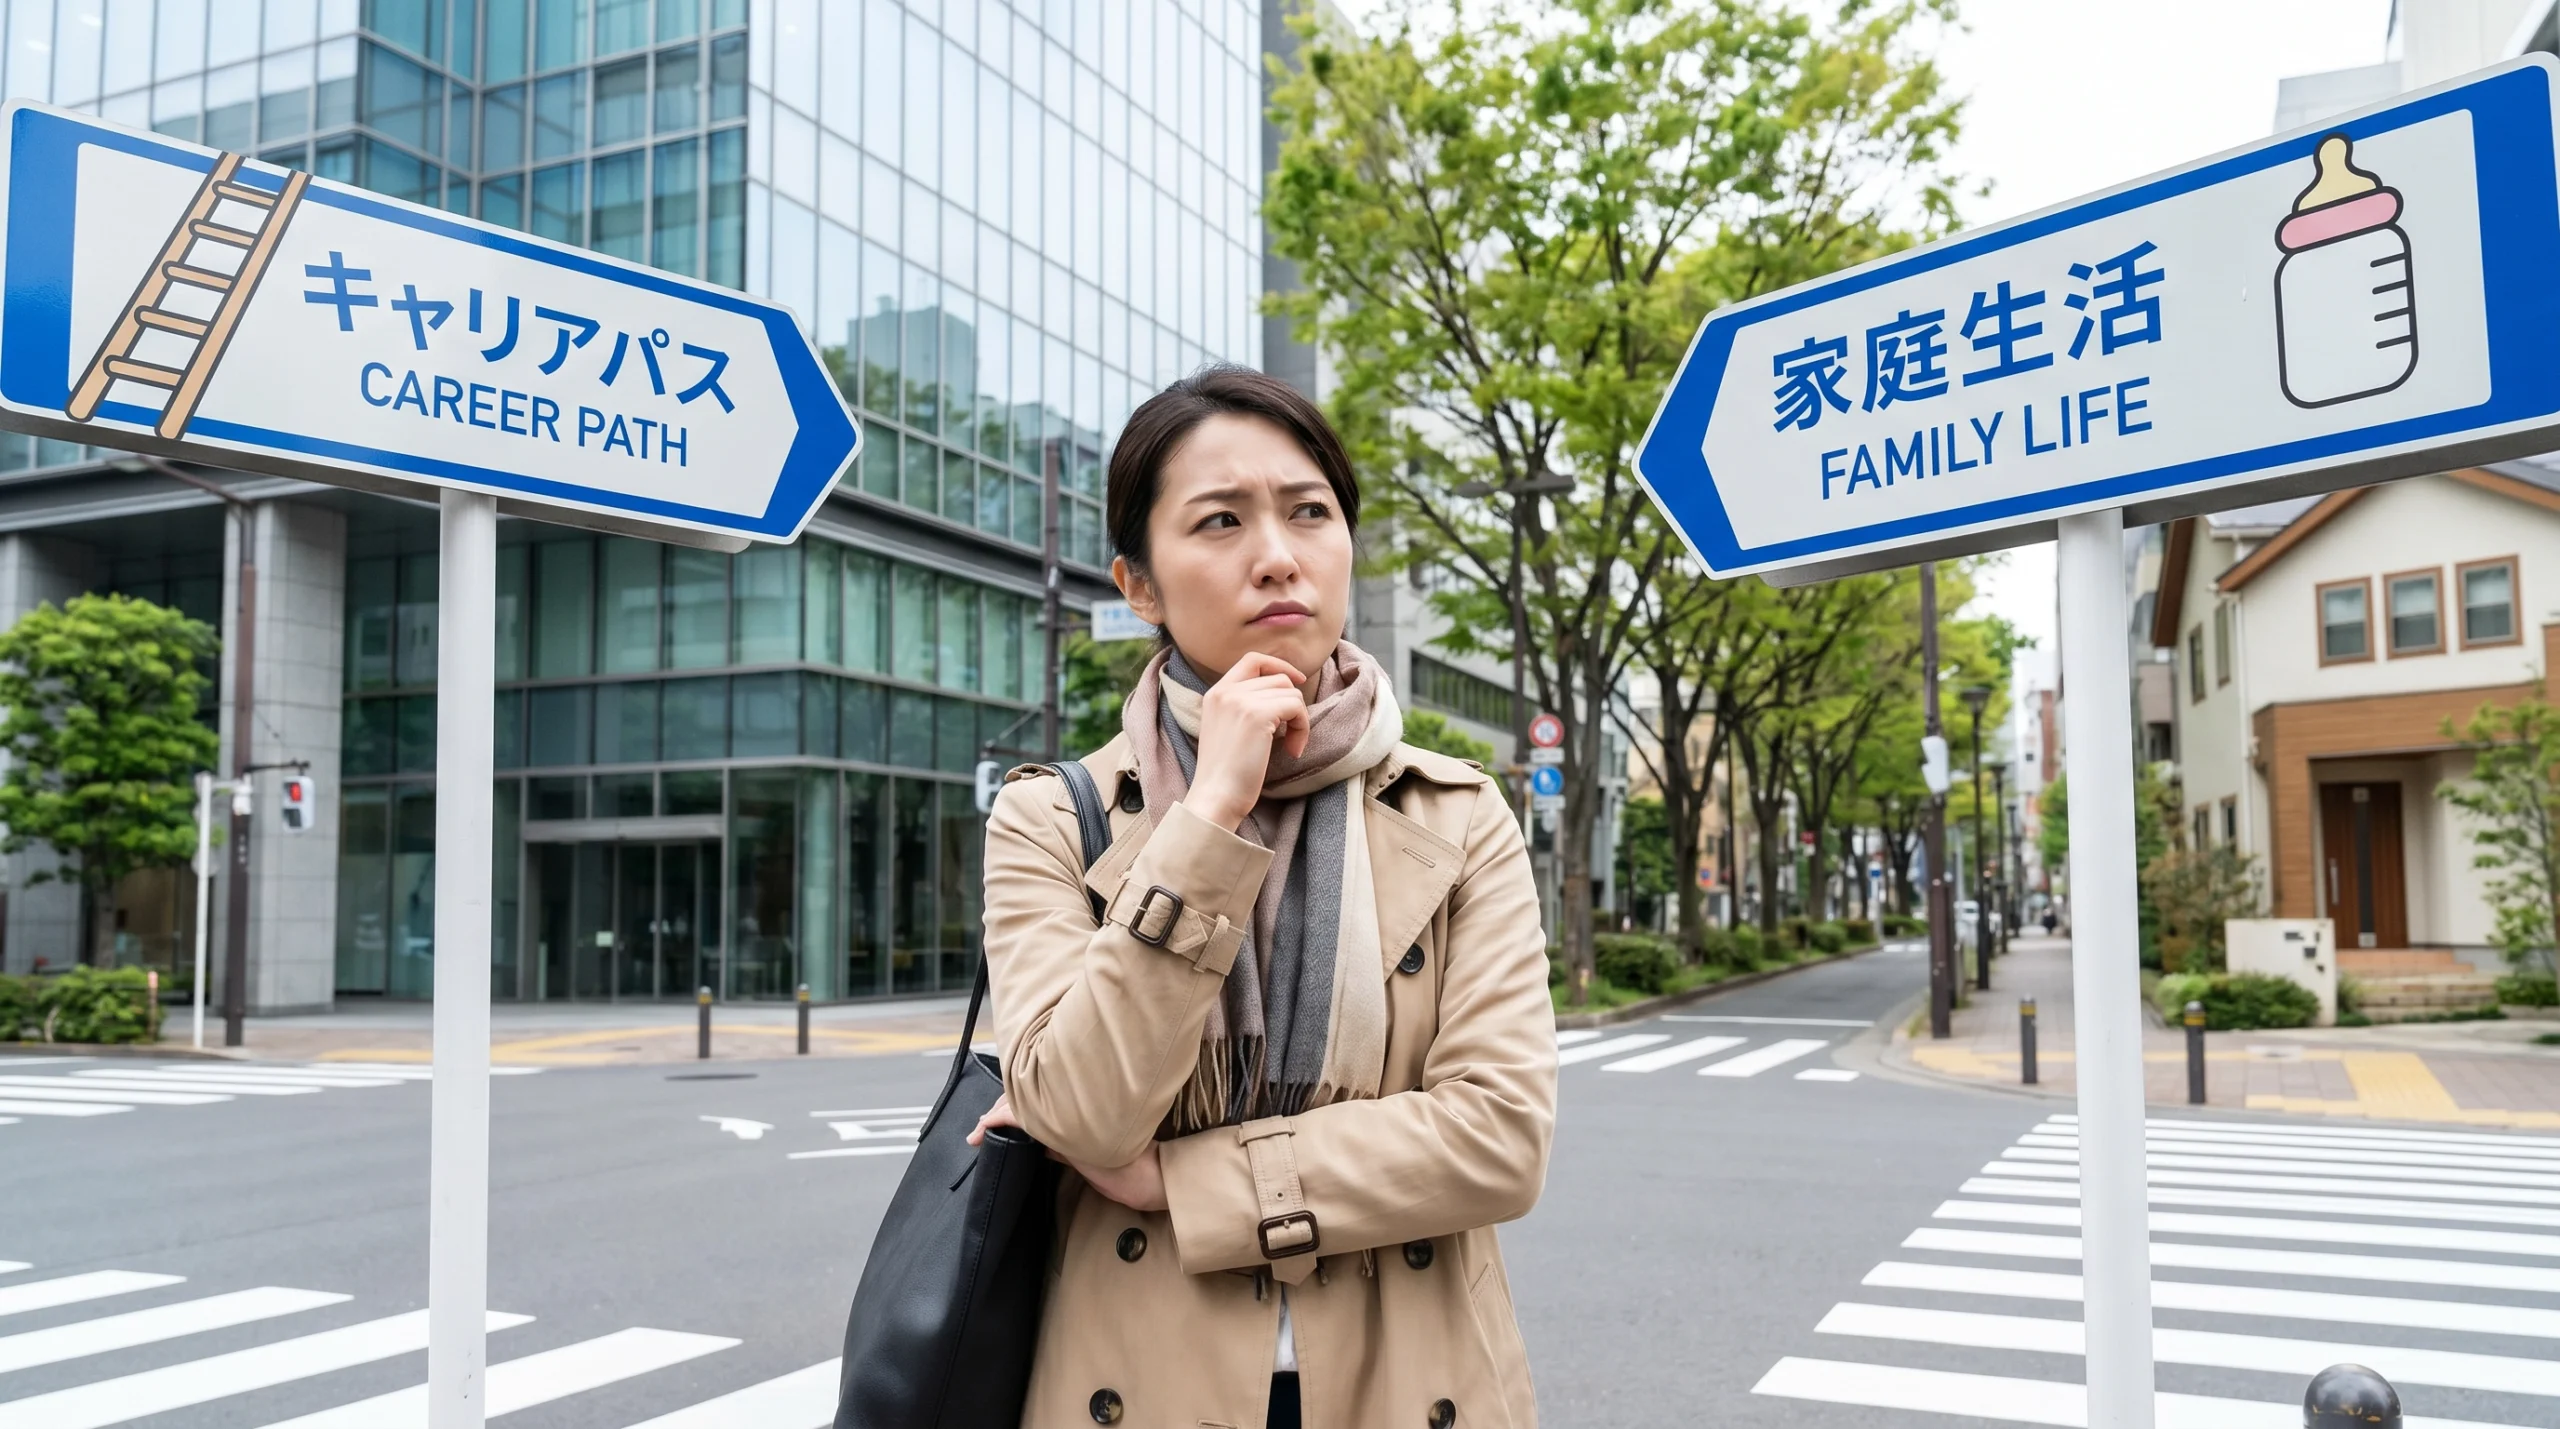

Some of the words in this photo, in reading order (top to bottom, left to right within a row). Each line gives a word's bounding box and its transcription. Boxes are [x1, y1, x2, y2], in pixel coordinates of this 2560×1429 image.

[303, 251, 735, 414] キャリアパス
[1772, 241, 2166, 433] 家庭生活
[360, 362, 561, 442] CAREER
[577, 405, 688, 467] PATH
[1821, 411, 2003, 500] FAMILY
[2023, 376, 2153, 457] LIFE
